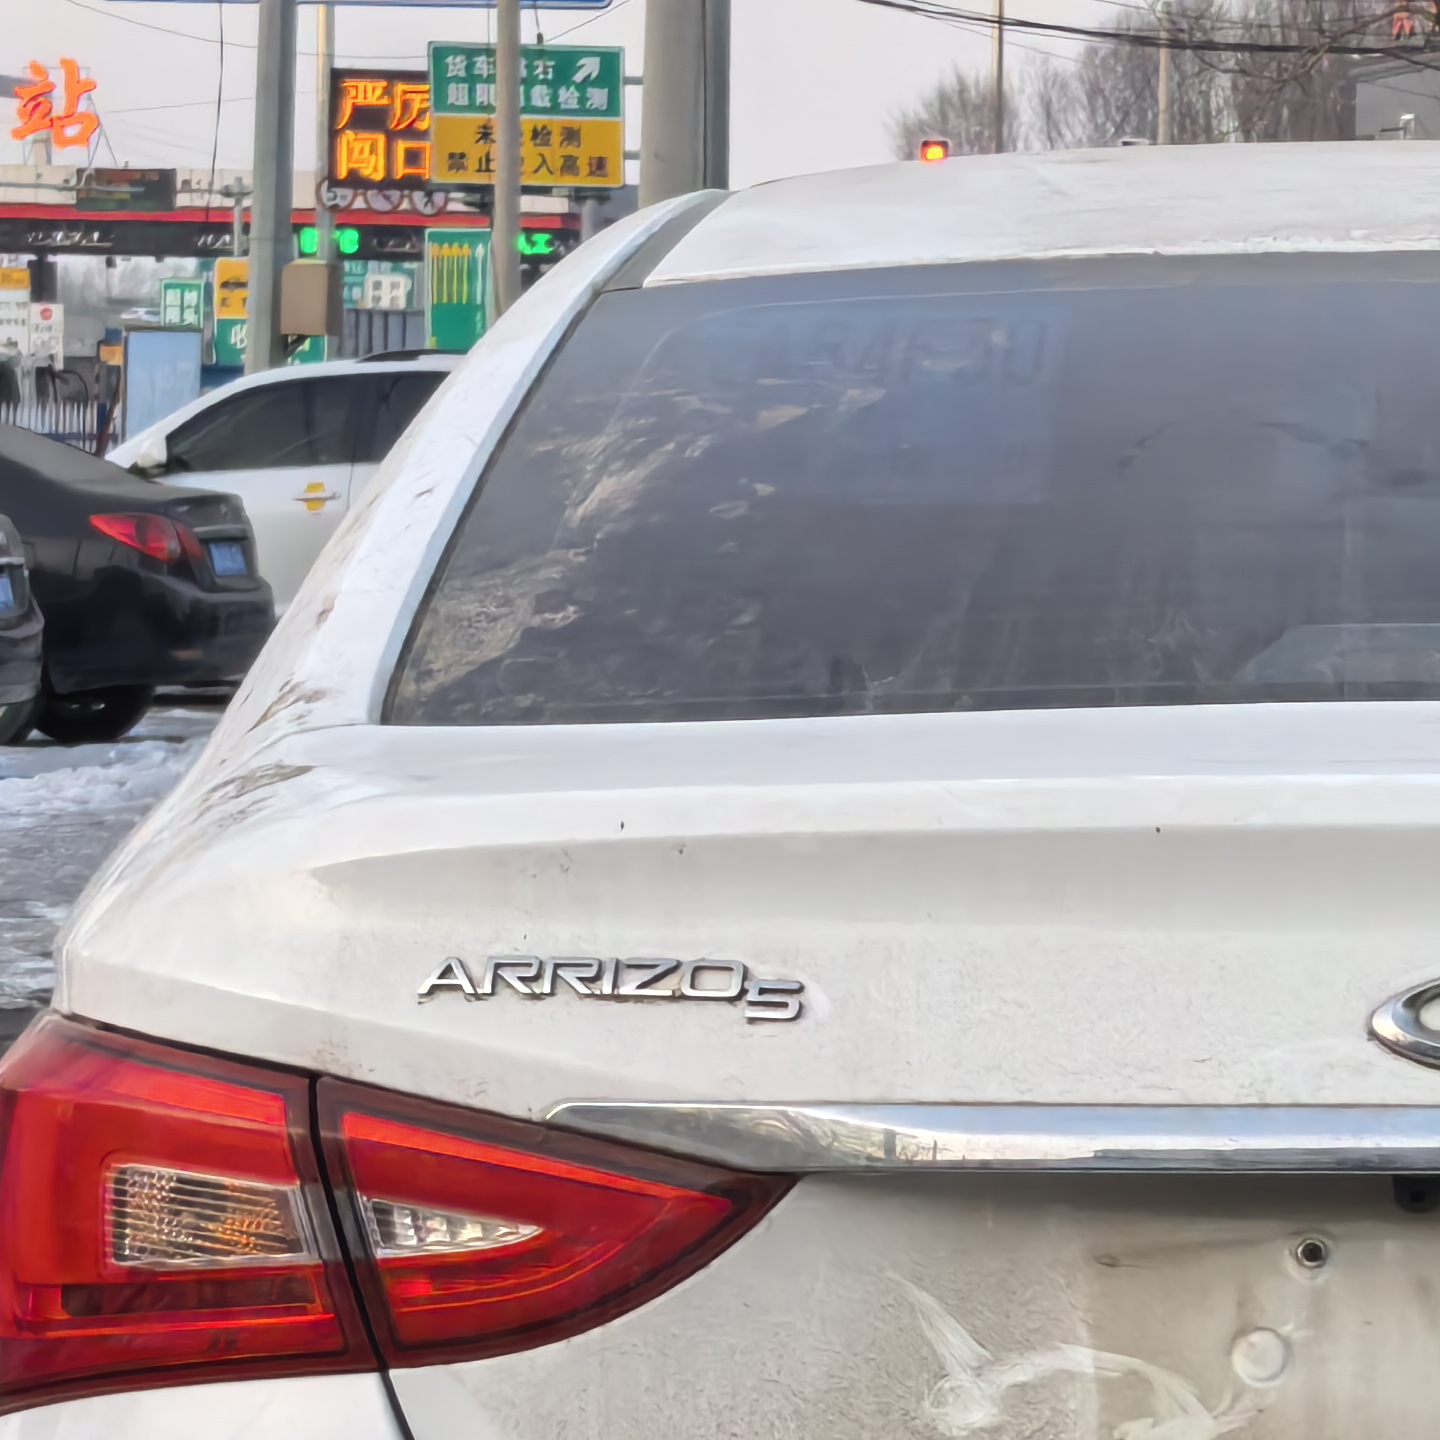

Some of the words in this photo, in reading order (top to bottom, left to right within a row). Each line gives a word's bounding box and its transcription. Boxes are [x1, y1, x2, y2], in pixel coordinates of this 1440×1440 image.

[444, 54, 556, 81] 货车右
[446, 82, 609, 111] 超限载检测
[474, 123, 582, 150] 未检测
[446, 150, 610, 178] 禁止入高速
